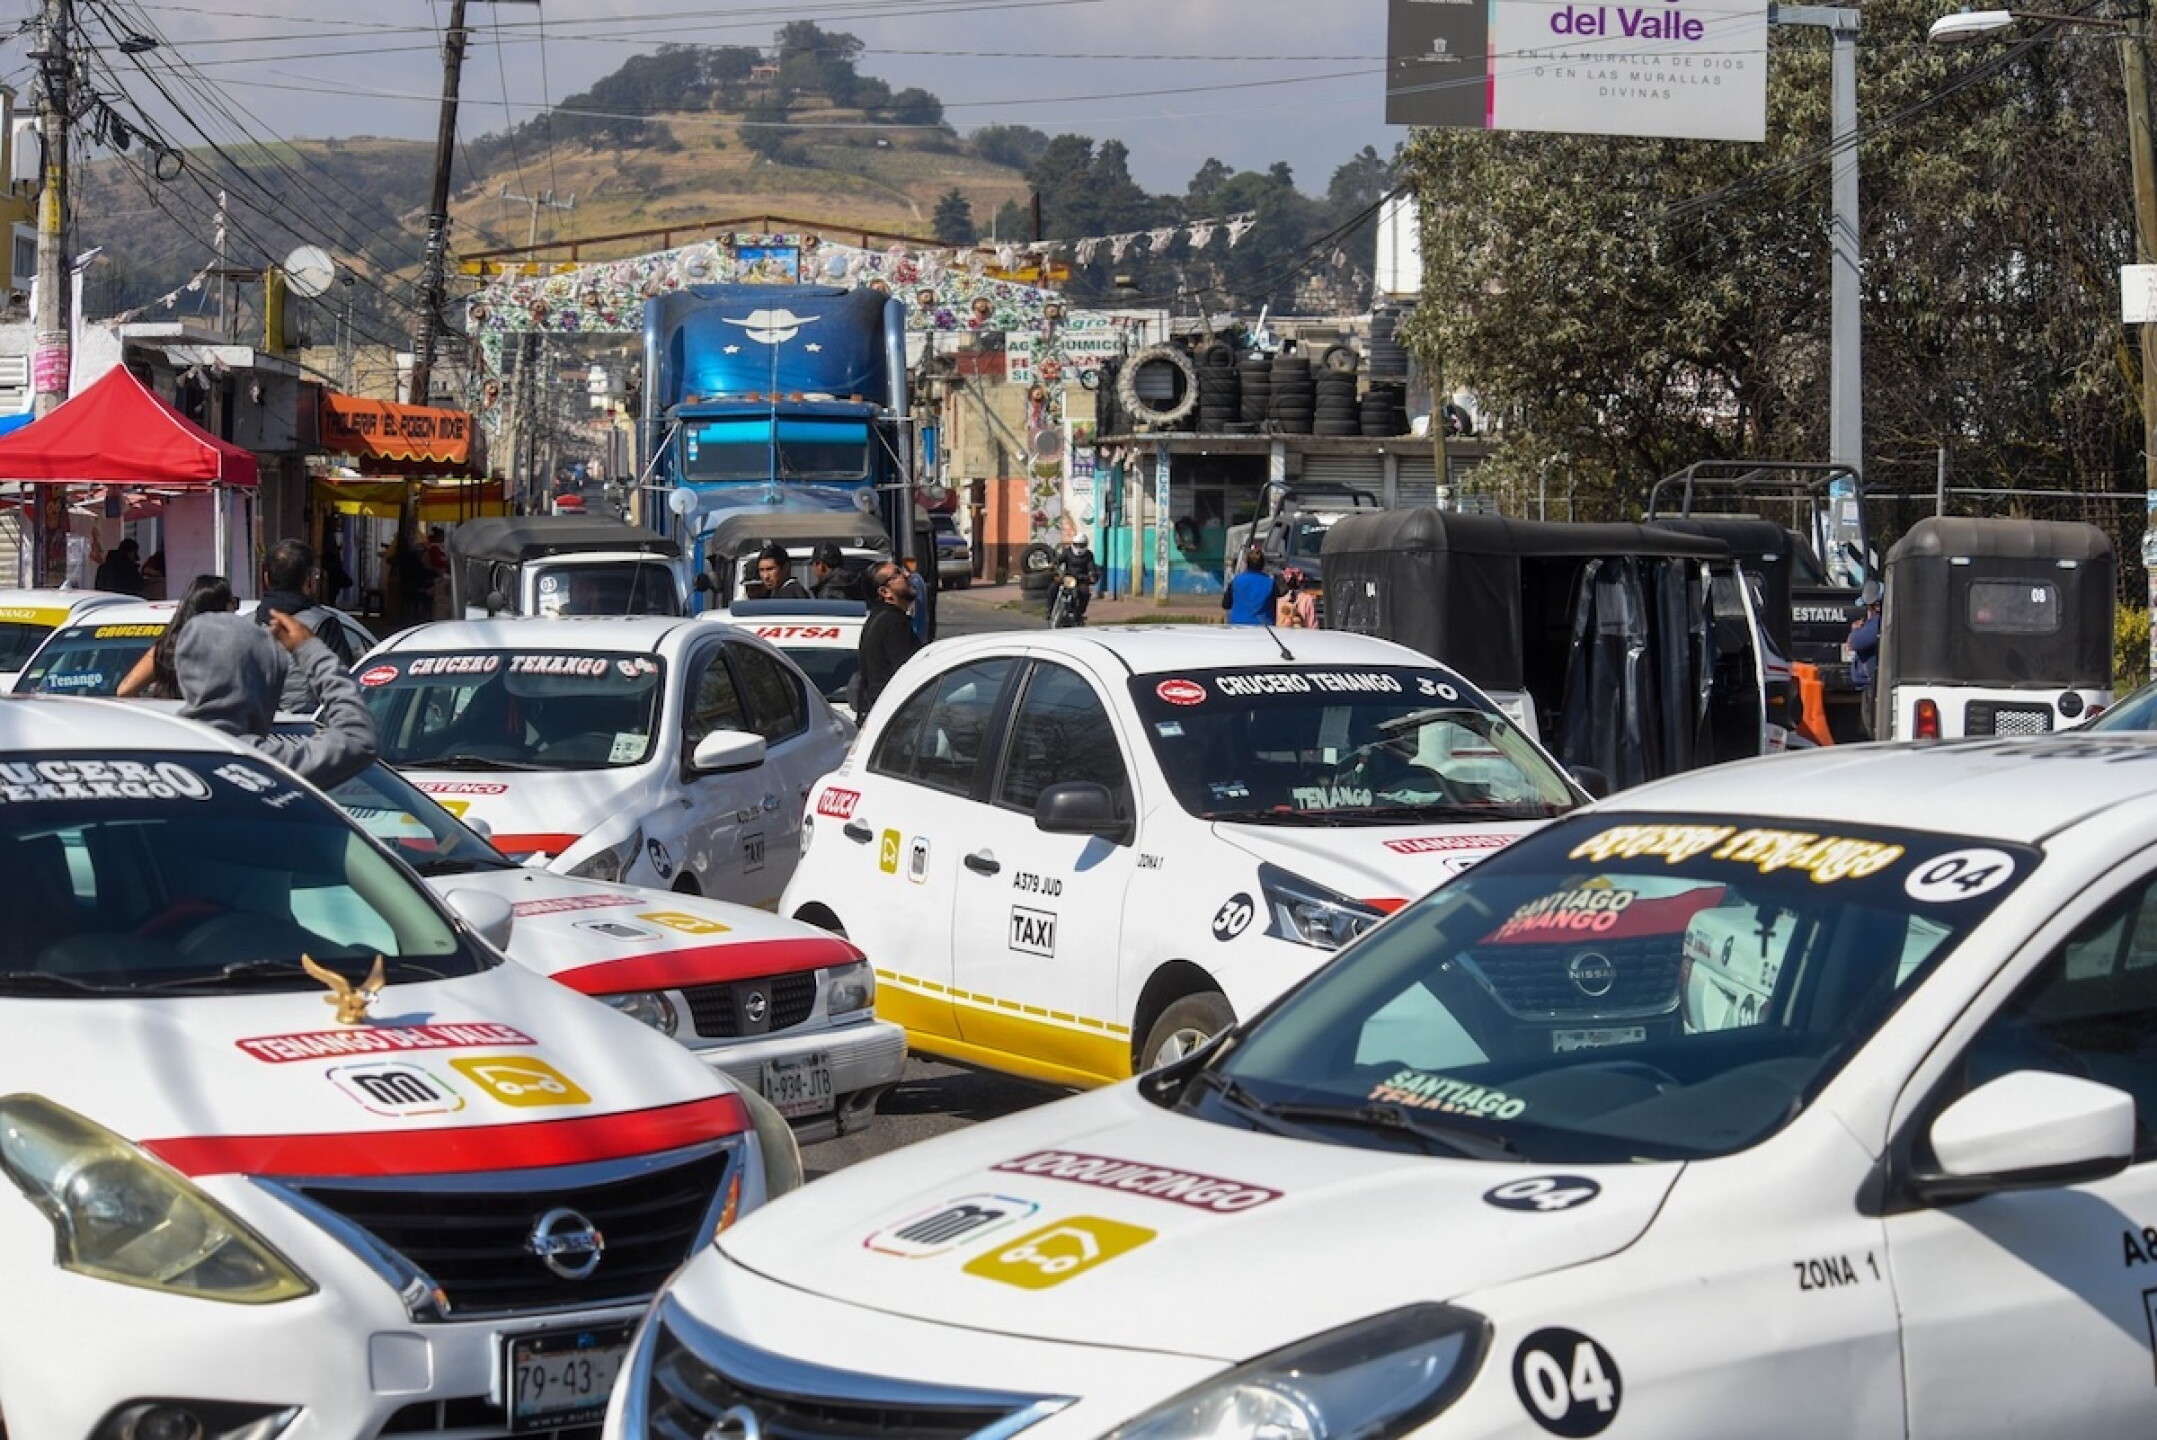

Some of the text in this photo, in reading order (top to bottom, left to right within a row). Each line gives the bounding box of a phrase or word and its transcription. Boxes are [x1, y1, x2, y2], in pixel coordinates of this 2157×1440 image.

[1550, 5, 1704, 41] del Valle
[1517, 50, 1745, 70] EN LA MURALLA DE DIOS
[1556, 68, 1576, 78] EN
[1587, 70, 1618, 81] LAS
[1630, 72, 1722, 86] MURALLAS
[1599, 86, 1672, 100] DIVINAS
[1792, 607, 1847, 622] ESTATAL
[94, 625, 167, 639] CRUCERO
[49, 673, 103, 688] Tenango
[408, 656, 499, 675] CRUCERO
[509, 656, 608, 676] TENANGO
[1215, 673, 1311, 695] CRUCERO
[1306, 673, 1402, 693] TENANGO
[1416, 677, 1458, 701] 30
[819, 788, 859, 818] TOLUCA
[1292, 787, 1373, 810] TENANGO
[1013, 871, 1063, 897] A379 JUD
[1920, 857, 2005, 893] 04
[1213, 898, 1251, 936] 30
[1514, 889, 1636, 919] SANTIAGO
[1013, 914, 1054, 948] TAXI
[1494, 910, 1619, 941] TENANGO
[246, 1021, 531, 1060] TENANGO DEL VALLE
[1385, 1070, 1527, 1121] SANTIAGO
[1000, 1150, 1271, 1210] JOQUICINGO
[1494, 1178, 1595, 1211] 04
[1793, 1250, 1882, 1291] ZONA 1
[1522, 1340, 1615, 1421] 04
